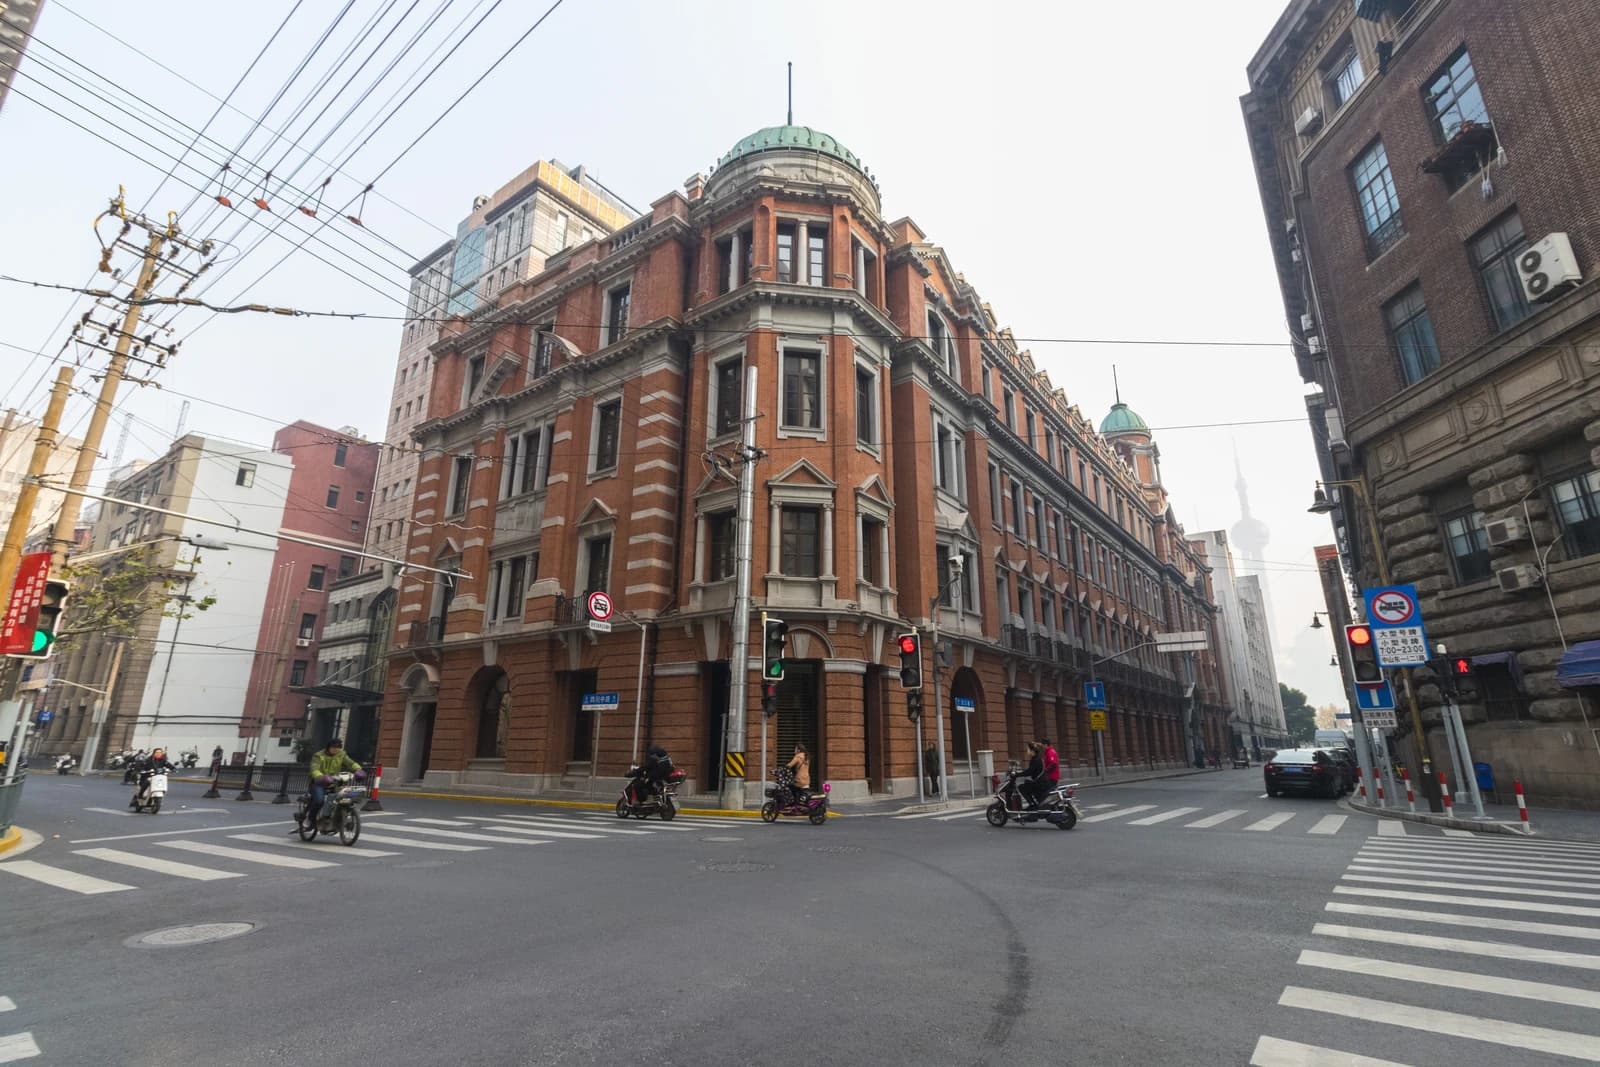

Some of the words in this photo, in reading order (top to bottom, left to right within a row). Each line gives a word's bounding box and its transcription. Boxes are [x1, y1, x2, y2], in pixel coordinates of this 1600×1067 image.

[1380, 628, 1417, 637] 大型号牌
[1381, 638, 1419, 646] 小型号牌
